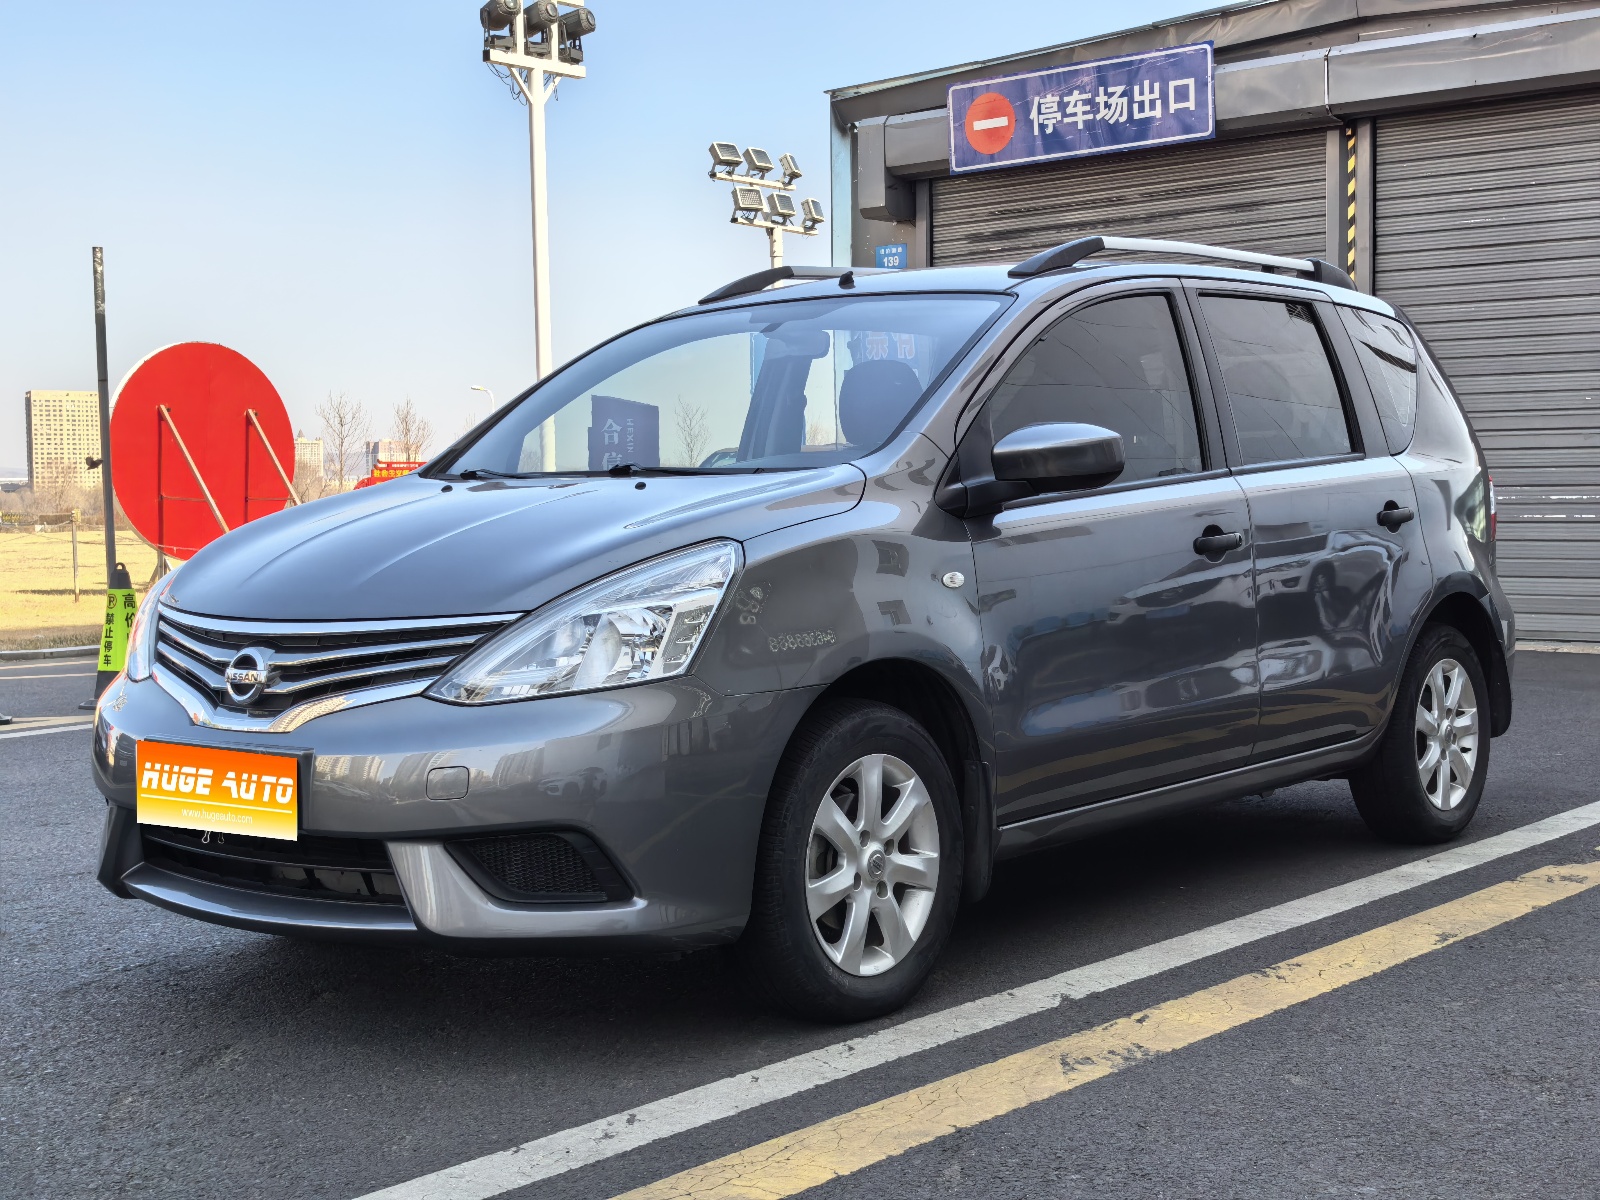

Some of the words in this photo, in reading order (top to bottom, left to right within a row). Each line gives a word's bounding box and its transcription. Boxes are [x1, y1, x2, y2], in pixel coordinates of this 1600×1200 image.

[1030, 77, 1196, 136] 停车场出口
[883, 255, 900, 267] 139
[626, 418, 635, 453] HEXIN
[103, 612, 115, 667] 禁止停车
[122, 593, 136, 641] 高价
